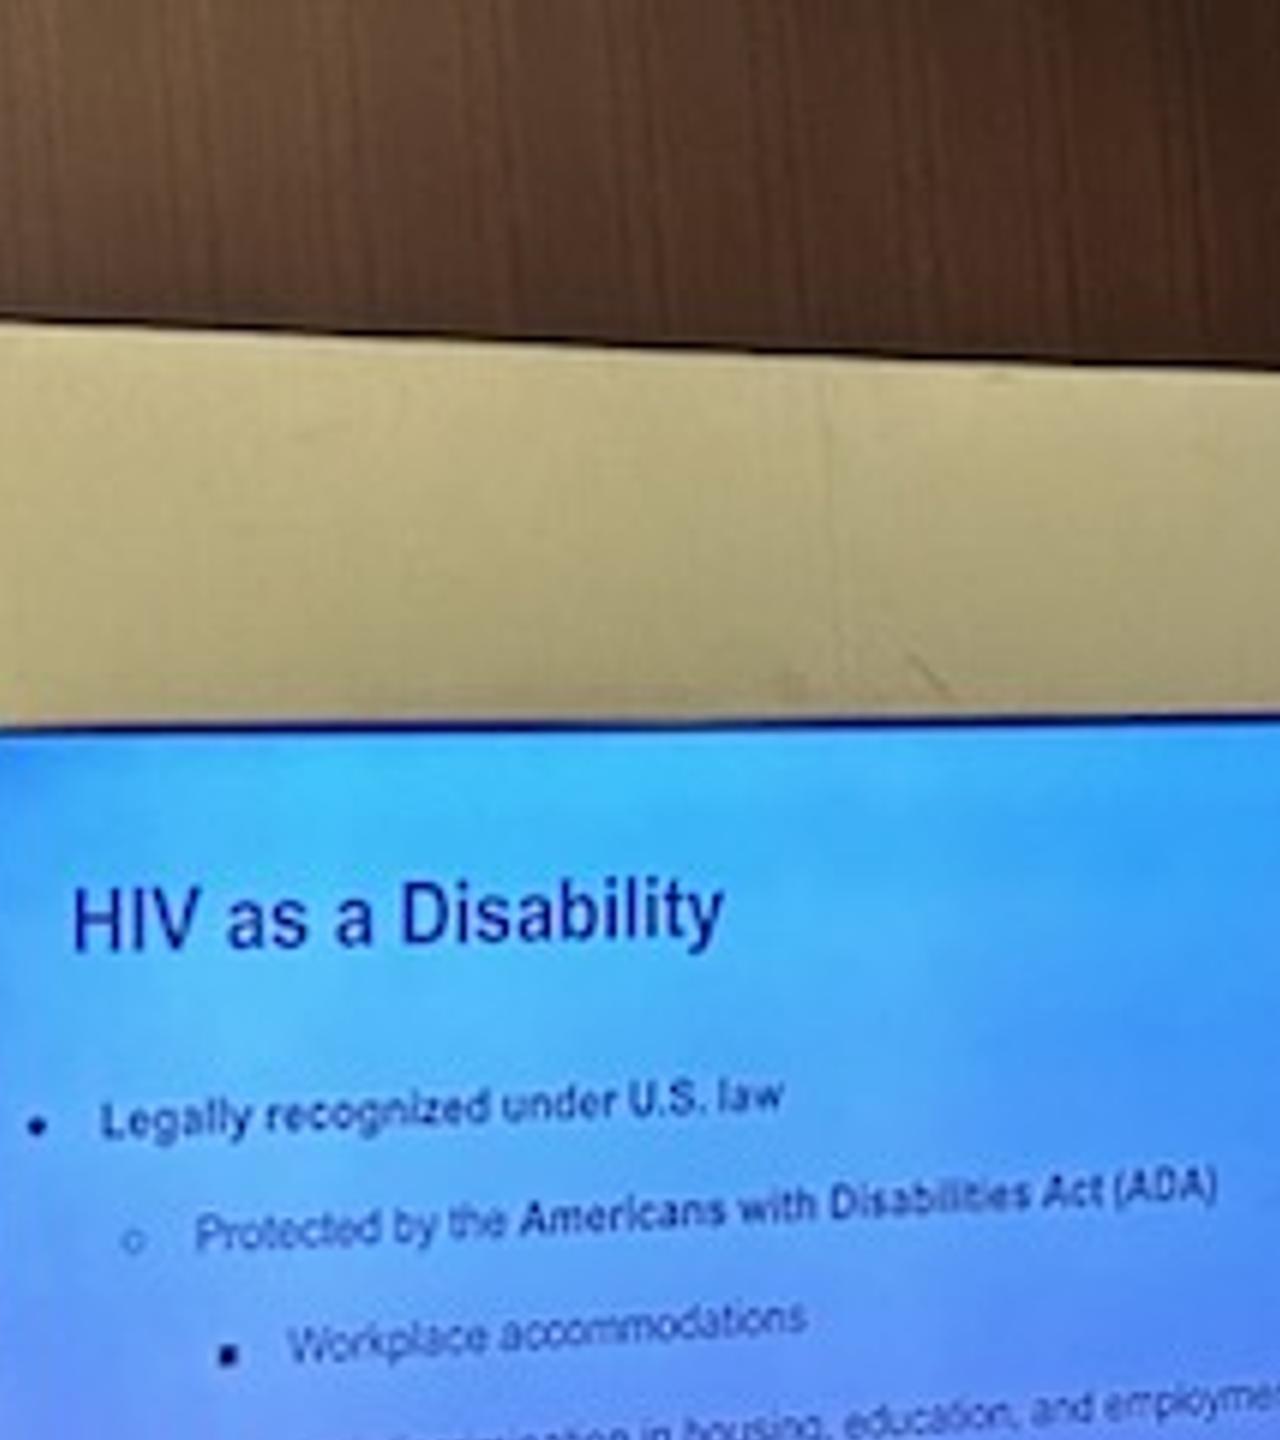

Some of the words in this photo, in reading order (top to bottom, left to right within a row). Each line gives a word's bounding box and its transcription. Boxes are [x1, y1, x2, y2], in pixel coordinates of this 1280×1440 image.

[73, 884, 202, 951] HIV
[227, 895, 308, 950] as
[336, 895, 375, 948] a
[402, 876, 725, 953] Disability
[101, 1097, 252, 1147] Legally
[267, 1089, 490, 1139] recognized
[503, 1084, 616, 1122] under
[632, 1080, 706, 1118] U.S.
[720, 1078, 784, 1113] law
[196, 1208, 381, 1252] Protected
[394, 1204, 436, 1251] by
[449, 1202, 506, 1240] the
[519, 1194, 725, 1237] Americans
[741, 1187, 818, 1227] with
[830, 1176, 1030, 1220] Disabilities
[1043, 1172, 1104, 1209] Act
[1115, 1164, 1217, 1211] (ADA)
[287, 1319, 489, 1365] Workplace
[499, 1301, 809, 1352] accommodations
[843, 1398, 1017, 1440] education,
[1030, 1391, 1094, 1426] and
